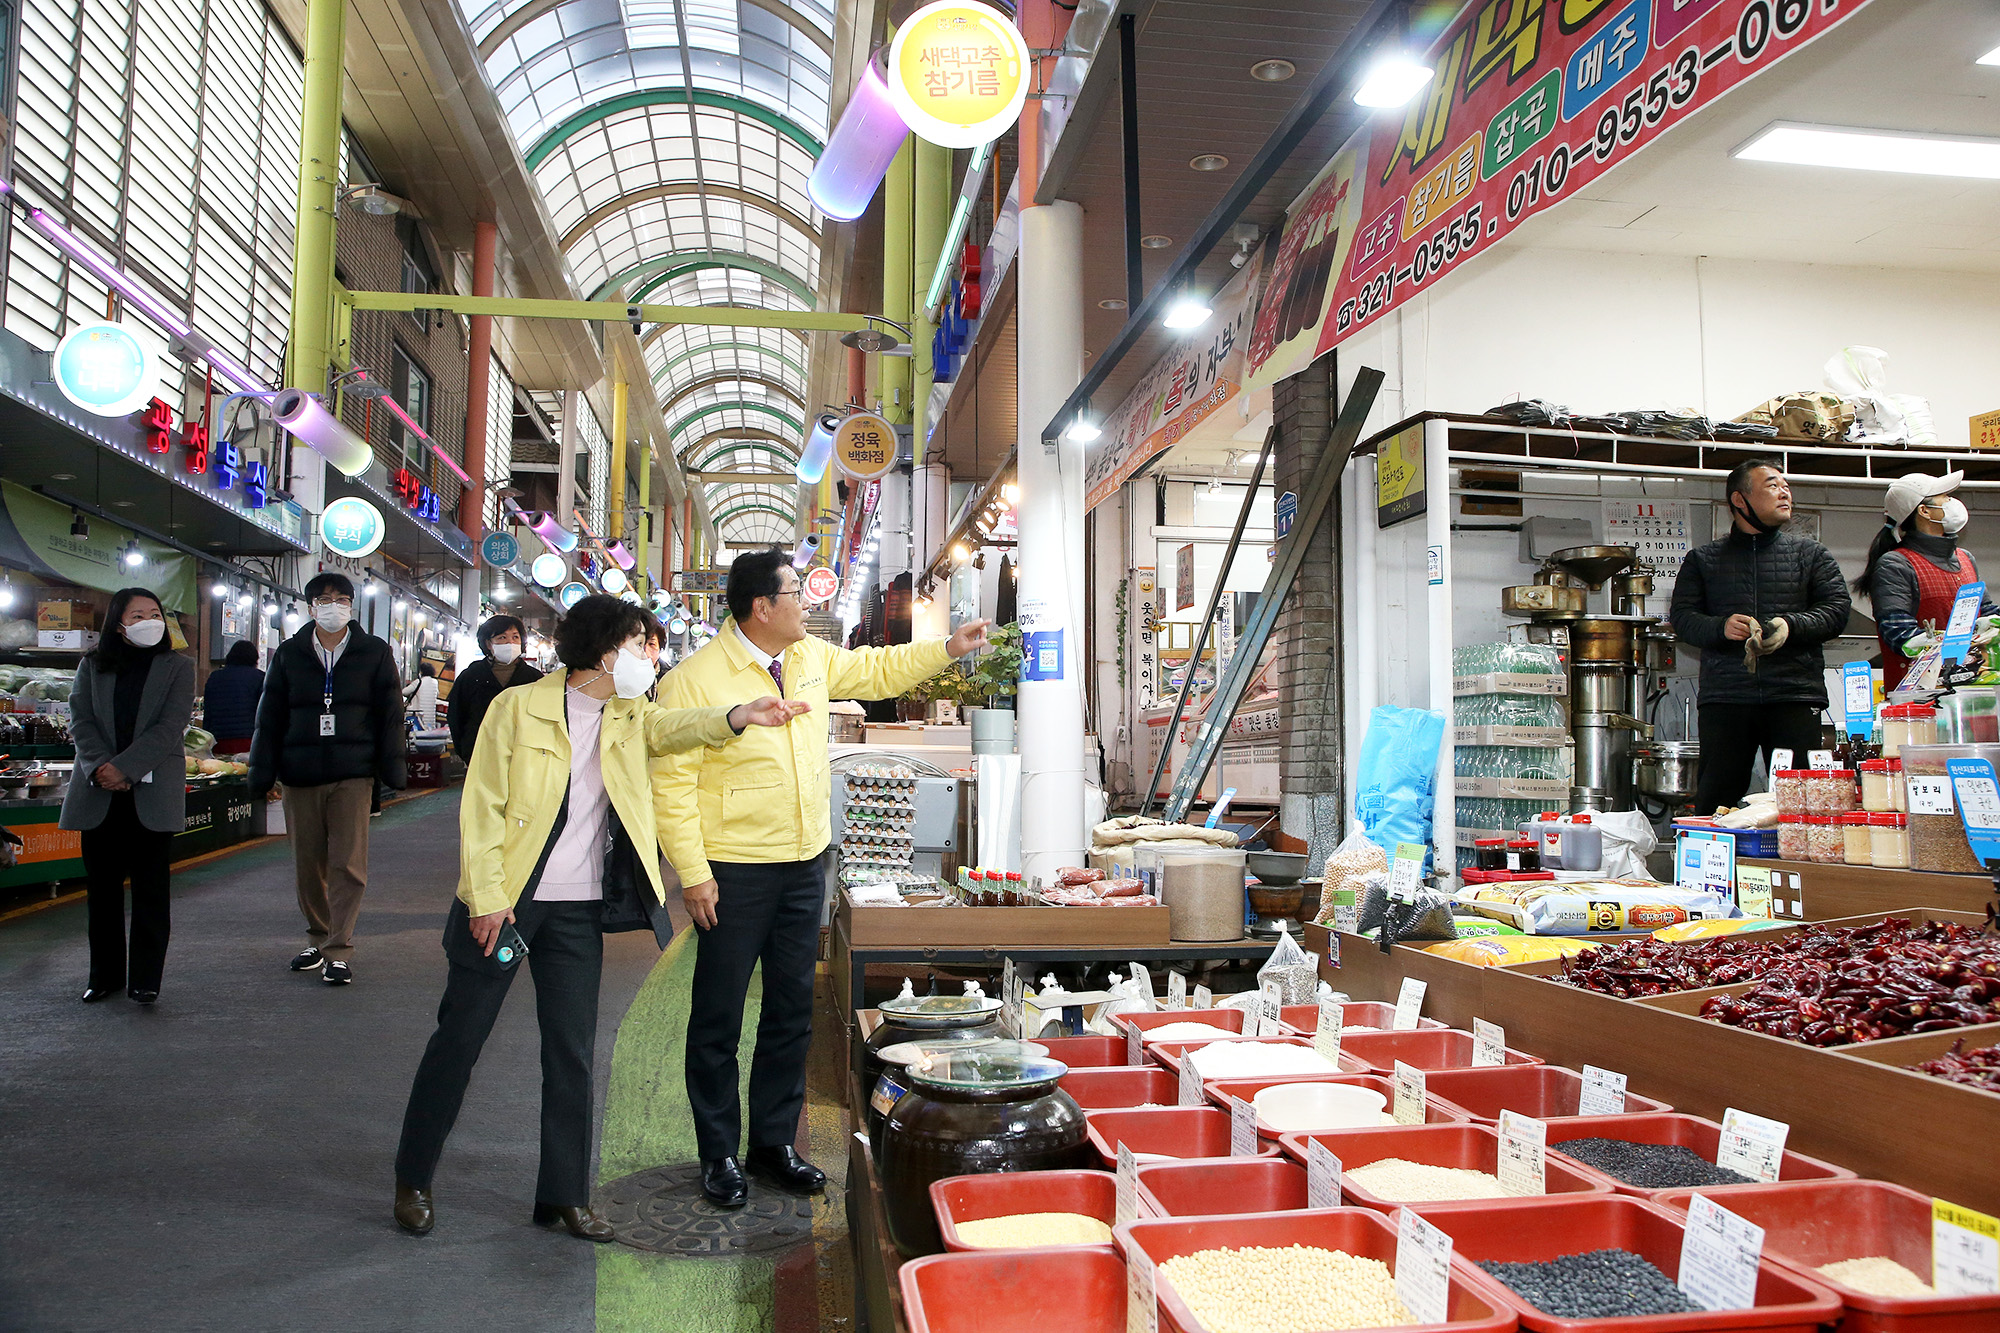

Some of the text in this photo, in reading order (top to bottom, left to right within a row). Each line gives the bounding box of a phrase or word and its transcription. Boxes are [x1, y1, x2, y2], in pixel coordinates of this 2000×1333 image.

[919, 46, 1002, 68] 새댁고추
[1577, 13, 1637, 92] 메주
[924, 69, 1001, 97] 참기름
[1507, 0, 1848, 220] 010-9553-06
[1494, 89, 1547, 158] 잡곡
[1411, 145, 1476, 226] 참기름
[1359, 217, 1396, 264] 고추
[851, 432, 880, 448] 정육
[848, 450, 884, 463] 백화점
[1637, 504, 1655, 517] 11
[334, 529, 361, 545] 부식
[1635, 528, 1683, 536] 1 2 3 4 5
[491, 541, 509, 552] 의성
[1646, 542, 1650, 550] 9
[1655, 542, 1664, 550] 10
[1667, 542, 1674, 550] 11
[1678, 542, 1686, 550] 12
[491, 552, 509, 560] 상회
[1645, 556, 1653, 564] 16
[1656, 556, 1664, 564] 17
[1667, 556, 1675, 564] 18
[1657, 570, 1676, 578] 24 25
[811, 578, 834, 588] BYC
[1141, 602, 1153, 644] 웃으면
[1951, 765, 1989, 774] 원산지표시판
